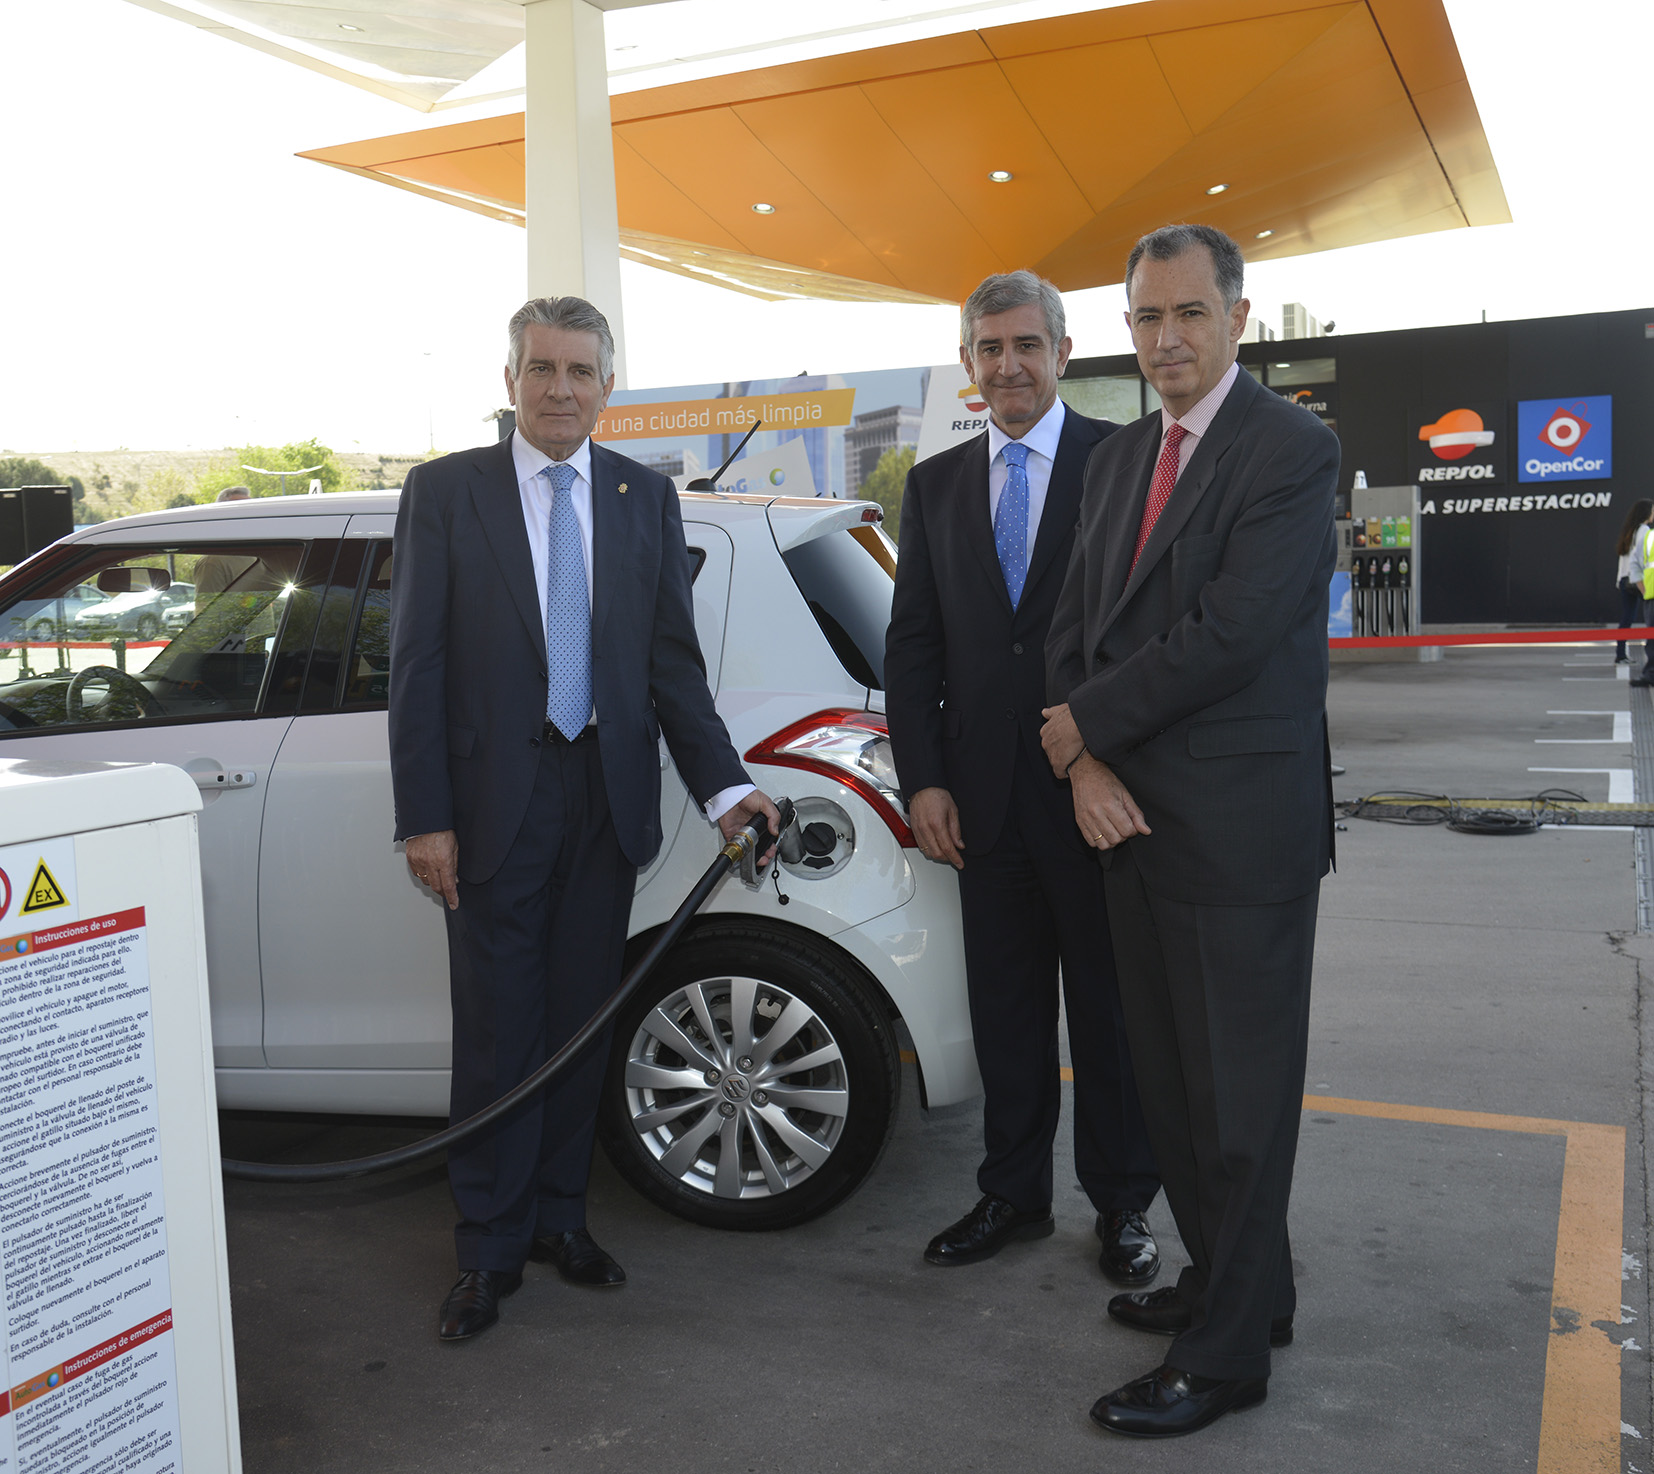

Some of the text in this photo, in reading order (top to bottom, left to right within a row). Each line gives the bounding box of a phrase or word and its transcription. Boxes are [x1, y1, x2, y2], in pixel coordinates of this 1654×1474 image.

[611, 416, 644, 433] una
[650, 408, 710, 430] ciudad
[716, 404, 756, 426] más
[763, 402, 822, 424] limpia
[952, 418, 988, 430] REPS
[1418, 464, 1495, 482] REPSOL
[1525, 456, 1604, 477] OpenCor
[1417, 492, 1612, 514] A SUPERESTACION
[36, 888, 52, 903] EX
[29, 954, 59, 967] vehículo
[61, 950, 76, 961] para
[86, 939, 116, 954] repostaje
[118, 934, 139, 944] dentro
[35, 919, 116, 944] Instrucciones de uso
[2, 980, 38, 998] prohibido
[40, 974, 65, 986] realizar
[67, 962, 110, 979] reparaciones
[111, 957, 121, 966] del
[52, 1006, 84, 1019] contacto,
[86, 996, 115, 1010] aparatos
[116, 986, 149, 1000] receptores
[36, 1039, 56, 1050] antes
[68, 1029, 89, 1040] iniciar
[98, 1016, 135, 1031] suministro,
[136, 1011, 149, 1021] que
[20, 1057, 60, 1076] compatible
[61, 1054, 74, 1063] con
[84, 1040, 114, 1056] boquerel
[115, 1031, 145, 1046] unificado
[2, 1138, 30, 1152] accione
[41, 1125, 64, 1141] gatillo
[65, 1115, 91, 1130] situado
[92, 1110, 107, 1120] bajo
[116, 1099, 140, 1111] mismo,
[0, 1176, 28, 1190] Accione
[29, 1159, 71, 1179] brevemente
[81, 1144, 110, 1162] pulsador
[122, 1127, 157, 1144] suministro,
[0, 1202, 41, 1223] desconecte
[43, 1184, 86, 1206] nuevamente
[95, 1166, 124, 1185] boquerel
[131, 1158, 153, 1170] vuelva
[0, 1193, 92, 1233] conectarlo correctamente.
[3, 1232, 57, 1259] continuamente
[59, 1219, 87, 1238] pulsado
[88, 1211, 106, 1223] hasta
[116, 1192, 152, 1211] finalización
[4, 1258, 16, 1270] del
[18, 1245, 53, 1264] repostaje.
[55, 1237, 70, 1248] Una
[71, 1232, 83, 1240] vez
[84, 1216, 119, 1235] finalizado,
[121, 1207, 139, 1219] libere
[11, 1227, 43, 1247] pulsador
[56, 1207, 92, 1227] suministro
[114, 1194, 124, 1202] ser
[6, 1216, 164, 1291] boquerel del vehículo, accionando nuevamente
[7, 1295, 34, 1311] válvula
[46, 1277, 74, 1294] llenado.
[8, 1308, 39, 1326] Coloque
[41, 1288, 84, 1311] nuevamente
[93, 1267, 123, 1287] boquerel
[142, 1250, 165, 1265] aparato
[9, 1319, 39, 1337] surtidor.
[21, 1335, 38, 1347] caso
[50, 1320, 70, 1333] duda,
[72, 1305, 101, 1322] consulte
[102, 1298, 115, 1308] con
[124, 1278, 151, 1300] personal
[11, 1337, 54, 1363] responsable
[75, 1310, 113, 1331] instalación.
[65, 1316, 172, 1374] Instrucciones de emergencia
[16, 1403, 61, 1430] incontrolada
[69, 1388, 90, 1403] través
[91, 1379, 102, 1391] del
[103, 1363, 132, 1384] boquerel
[134, 1352, 158, 1368] accione
[17, 1406, 74, 1441] inmediatamente
[84, 1385, 114, 1407] pulsador
[115, 1377, 128, 1388] rojo
[18, 1425, 61, 1451] emergencia.
[30, 1428, 84, 1460] eventualmente,
[94, 1404, 123, 1427] pulsador
[134, 1381, 167, 1402] suministro
[50, 1435, 88, 1459] bloqueado
[107, 1408, 135, 1430] posición
